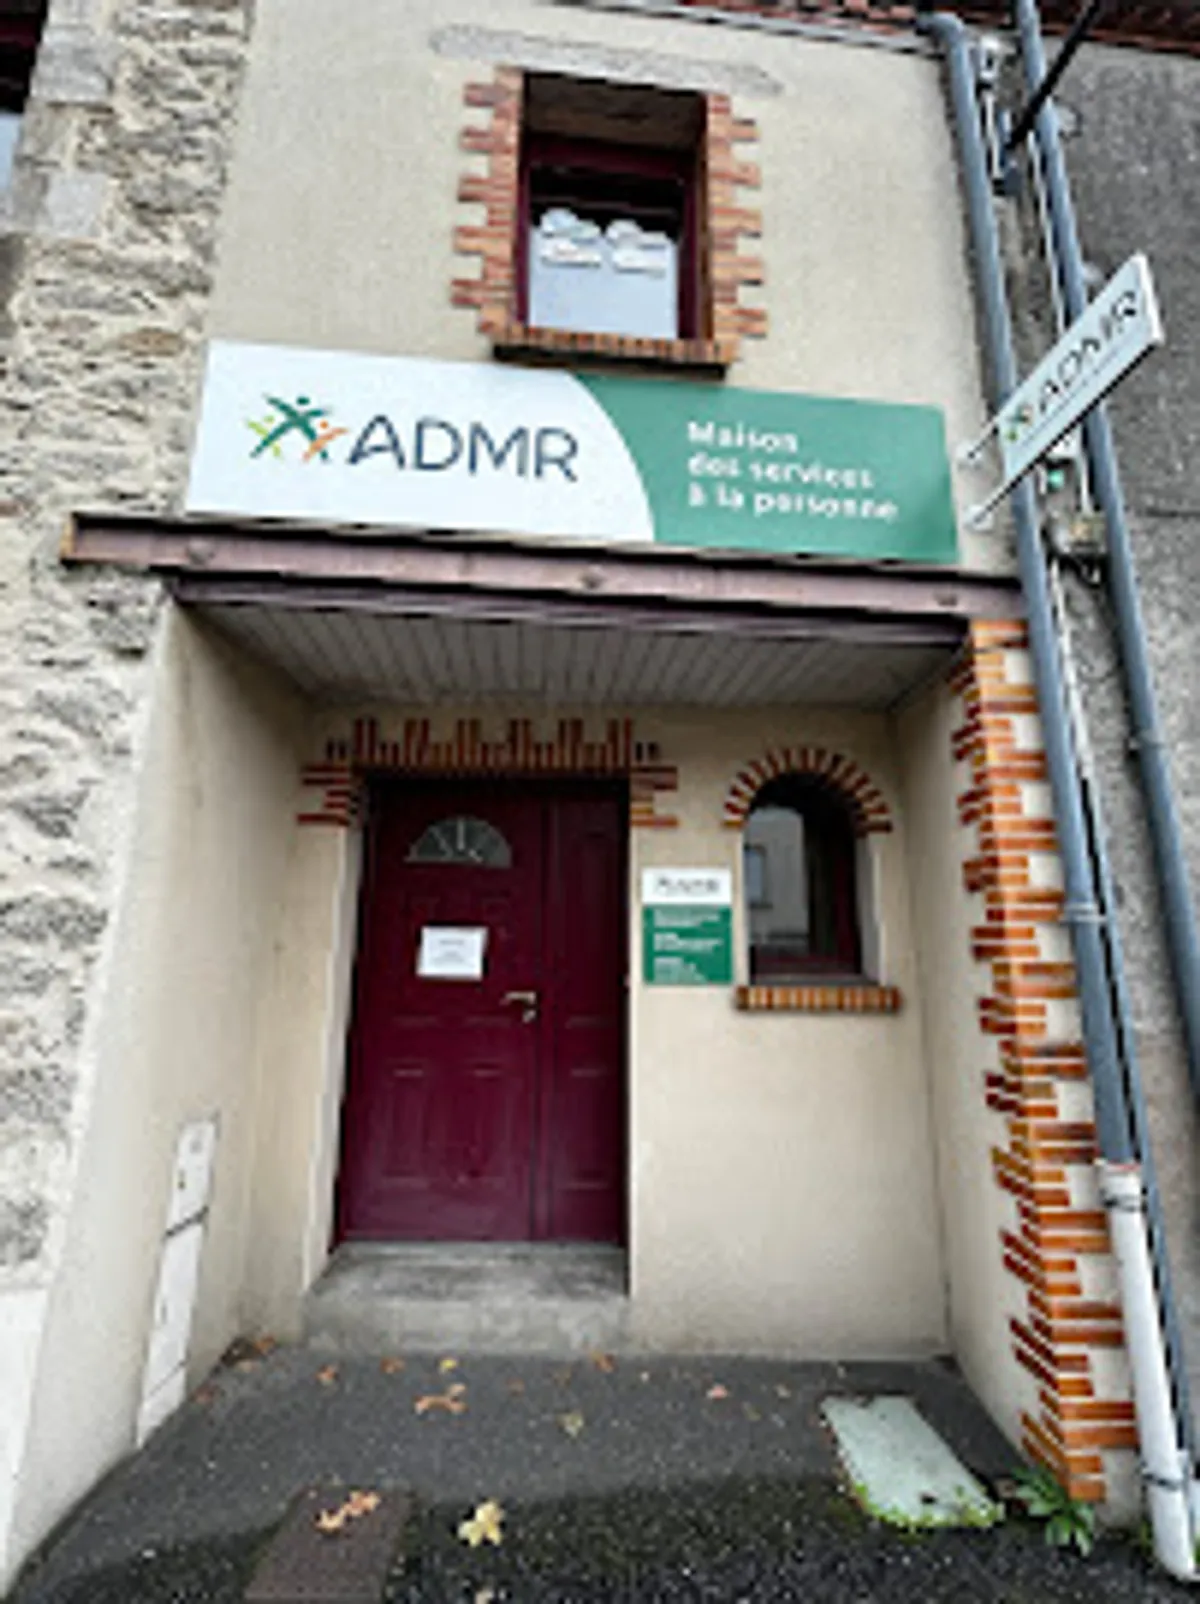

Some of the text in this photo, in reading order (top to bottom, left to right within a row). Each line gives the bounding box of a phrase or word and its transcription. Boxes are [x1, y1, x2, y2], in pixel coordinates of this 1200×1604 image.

[1039, 290, 1137, 413] ADMR
[347, 413, 579, 483] ADMR
[687, 421, 798, 453] Maison
[687, 452, 874, 489] des services
[716, 482, 745, 511] la
[753, 490, 898, 523] personne
